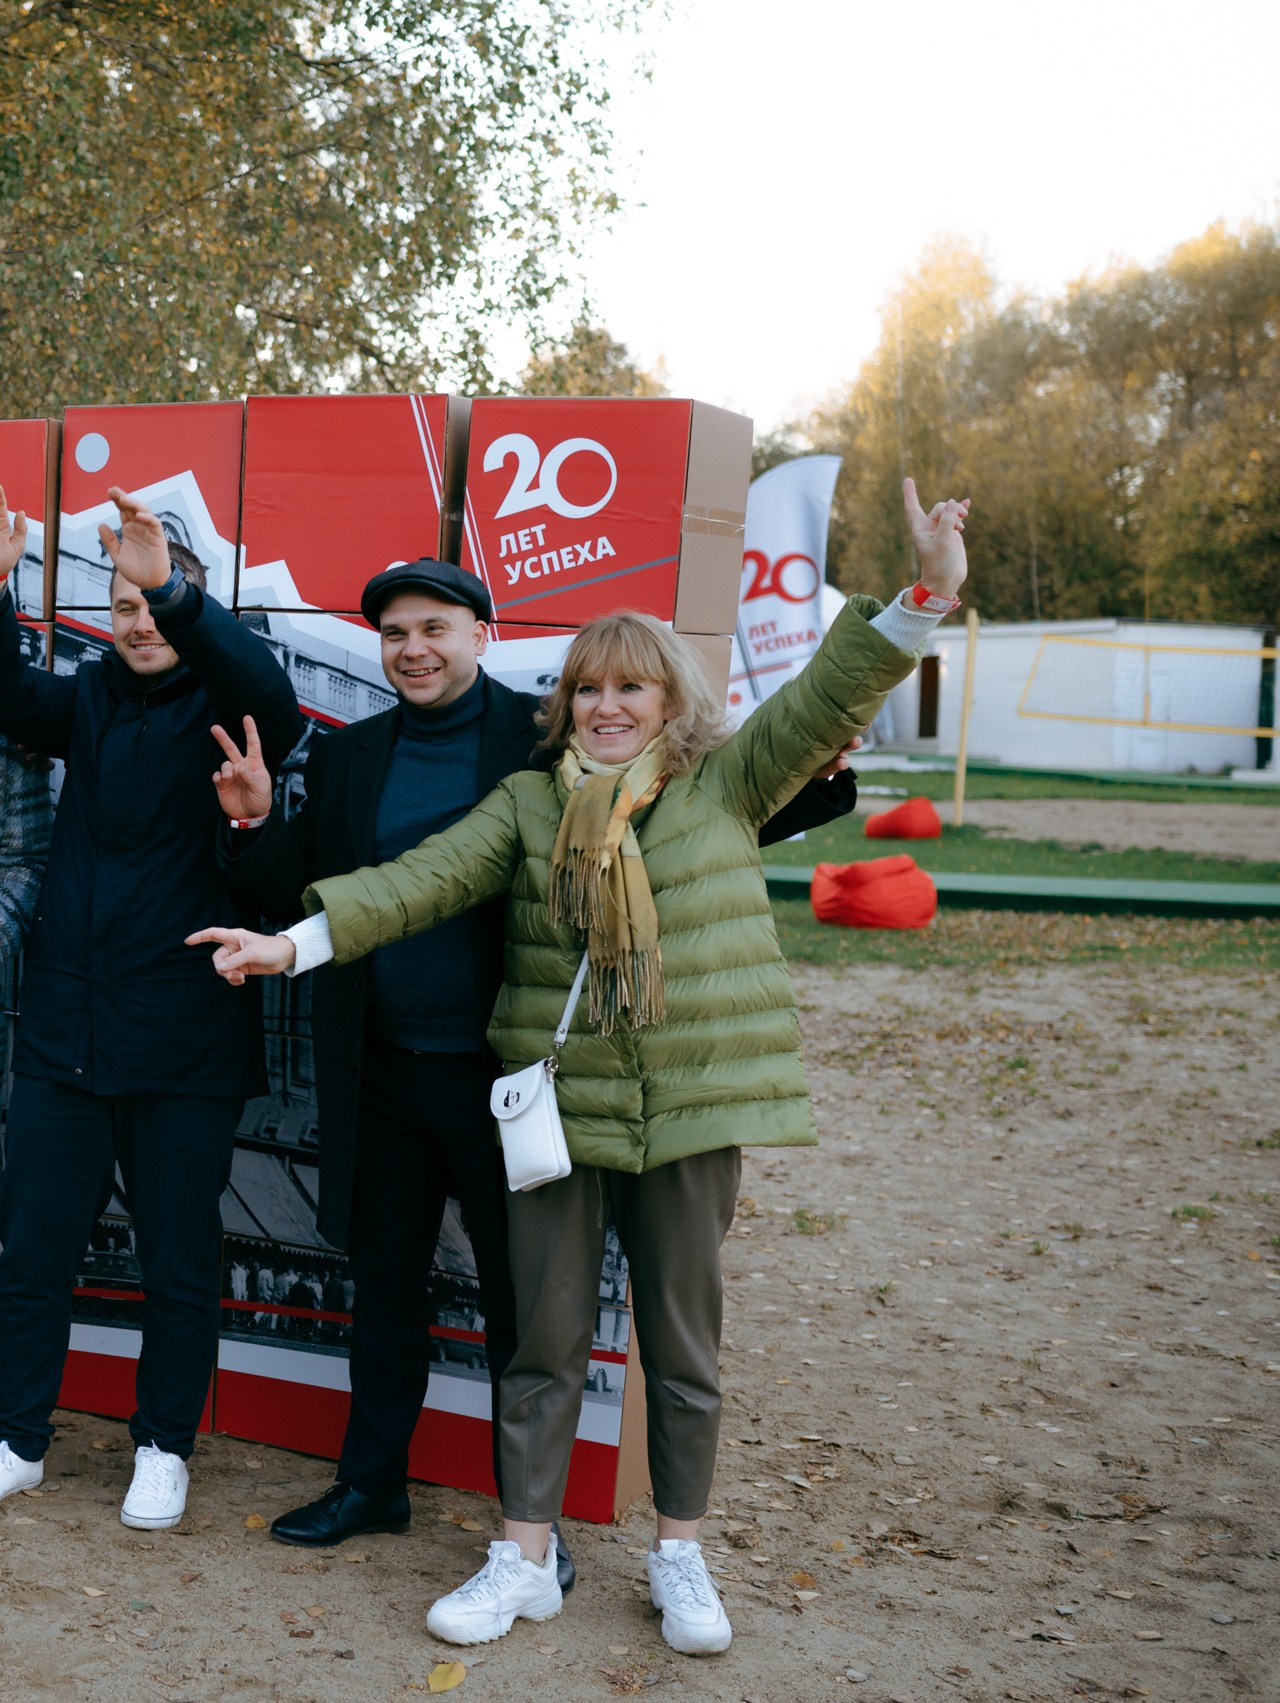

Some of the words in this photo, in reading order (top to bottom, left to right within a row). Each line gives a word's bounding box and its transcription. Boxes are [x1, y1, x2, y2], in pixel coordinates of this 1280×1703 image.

[483, 433, 618, 520] 20
[498, 523, 546, 558] ЛЕТ
[504, 536, 617, 585] УСПЕХА
[741, 549, 820, 605] 20
[748, 619, 778, 641] ЛЕТ
[752, 628, 818, 656] УСПЕХА
